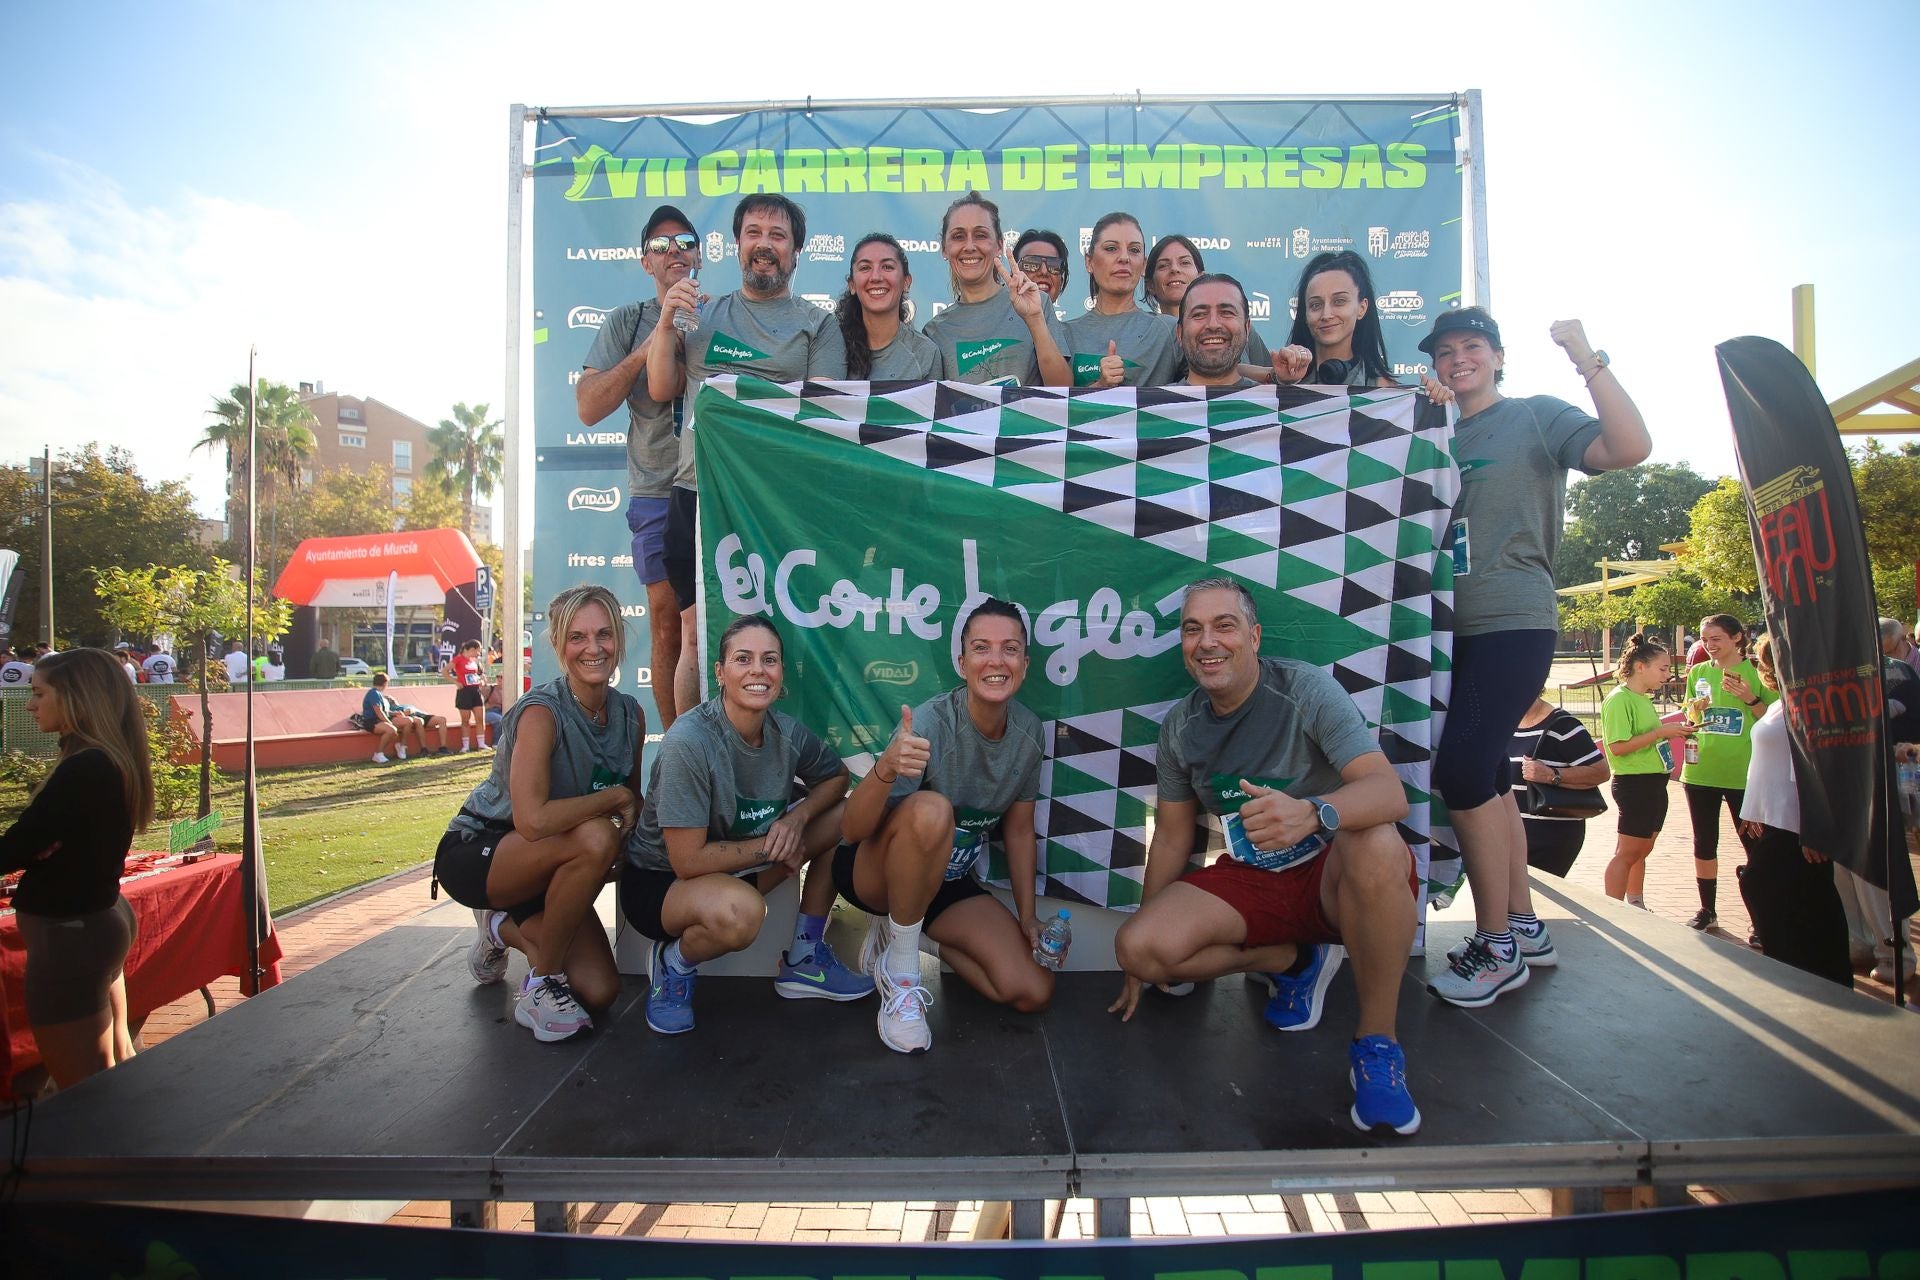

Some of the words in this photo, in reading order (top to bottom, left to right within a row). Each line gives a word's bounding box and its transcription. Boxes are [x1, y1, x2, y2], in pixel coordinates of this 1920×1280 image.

[698, 147, 991, 198] CARRERA
[1001, 144, 1078, 192] DE
[1089, 143, 1427, 191] EMPRESAS
[897, 239, 940, 252] RDAD
[1246, 240, 1281, 248] MURCIA
[1311, 237, 1353, 245] Ayuntamiento
[1390, 242, 1430, 250] ATLETISMO
[567, 247, 588, 260] LA
[804, 245, 845, 253] ATLETISMO
[575, 312, 606, 324] VIDA
[1394, 363, 1428, 375] Hero
[566, 433, 586, 445] LA
[587, 432, 627, 445] VERD
[575, 494, 613, 505] VIDAL
[305, 547, 368, 565] Ayuntamiento
[369, 544, 382, 557] de
[383, 540, 418, 556] Murcia
[568, 553, 606, 567] itres
[774, 549, 943, 640] Corte
[872, 667, 911, 678] VIDAL
